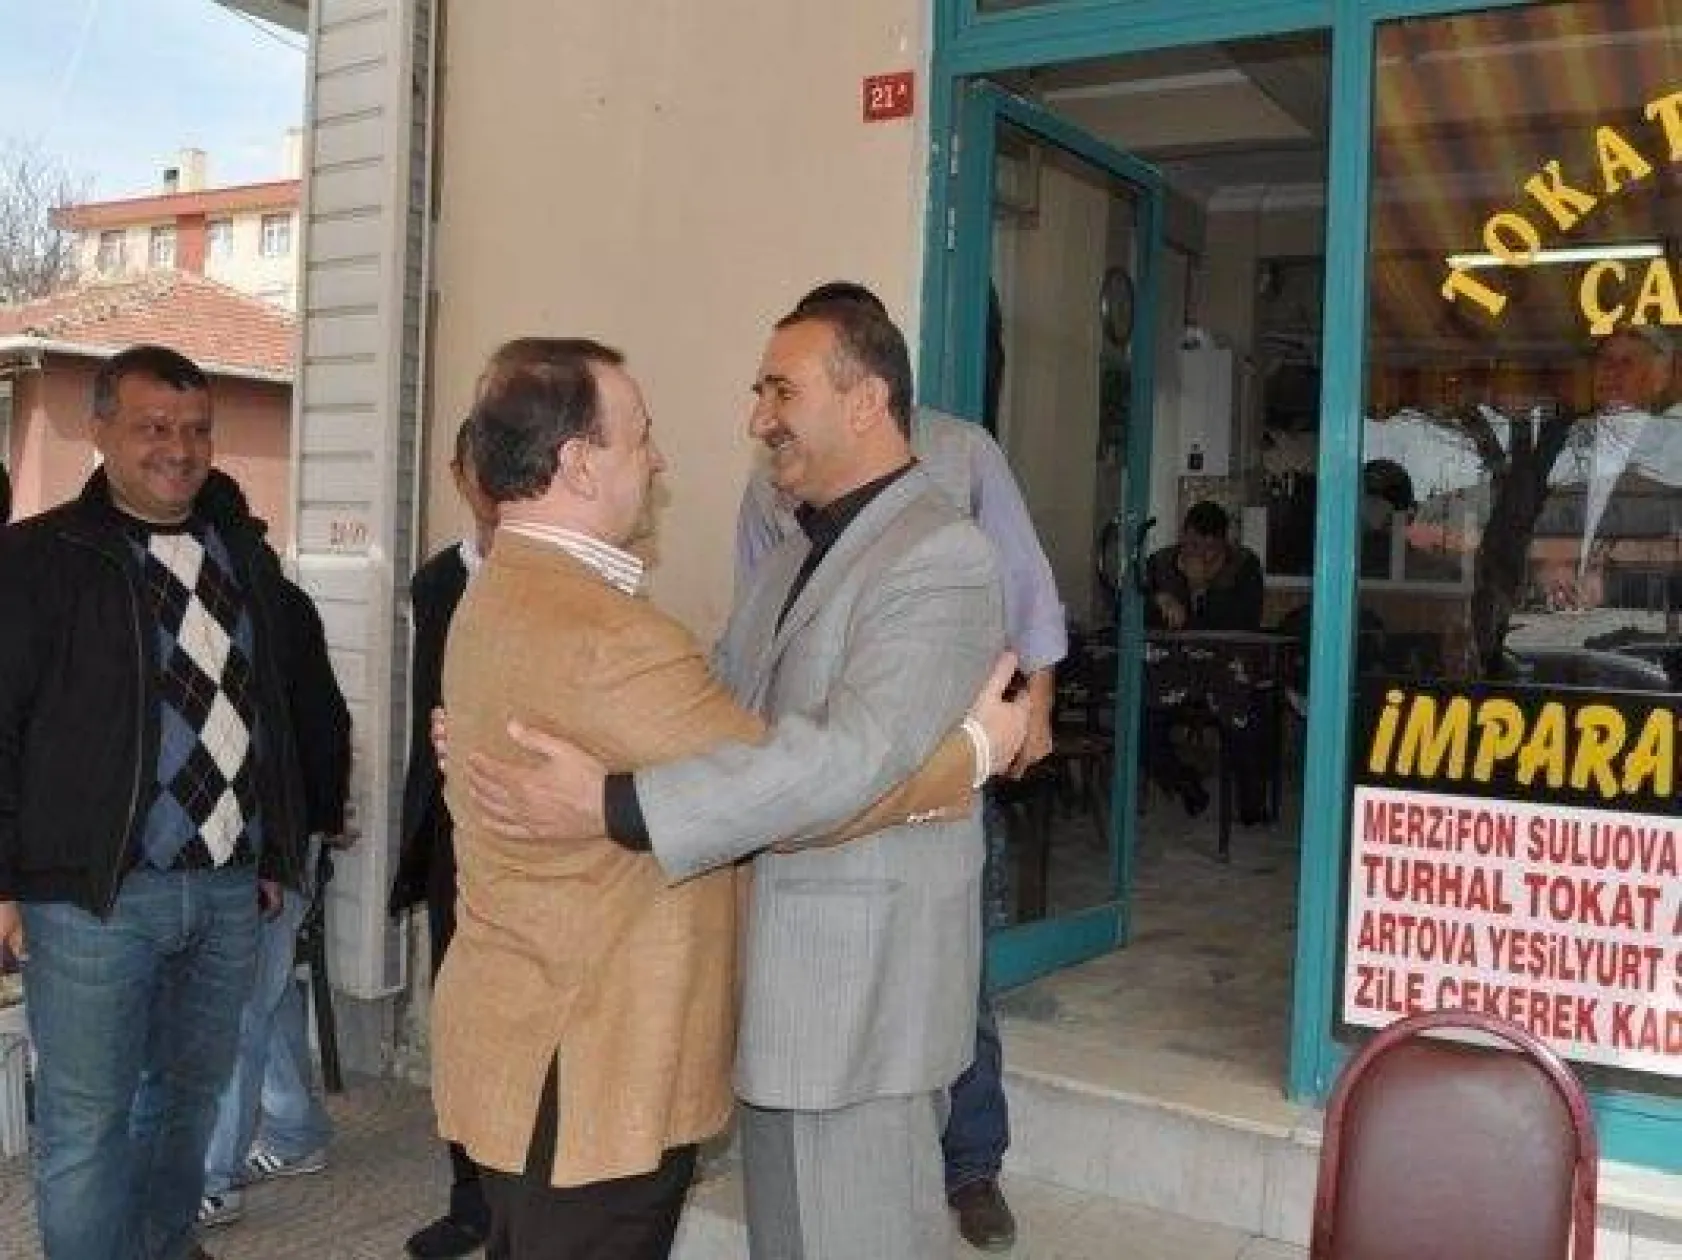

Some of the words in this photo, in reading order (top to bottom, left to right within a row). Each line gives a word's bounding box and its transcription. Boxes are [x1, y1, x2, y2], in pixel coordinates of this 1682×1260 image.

[871, 84, 894, 108] 21
[1441, 91, 1682, 317] TOKAT
[1527, 815, 1678, 877] SULUOVA
[1361, 853, 1513, 914] TURHAL
[1524, 872, 1662, 933] TOKAT
[1357, 909, 1478, 968] ARTOVA
